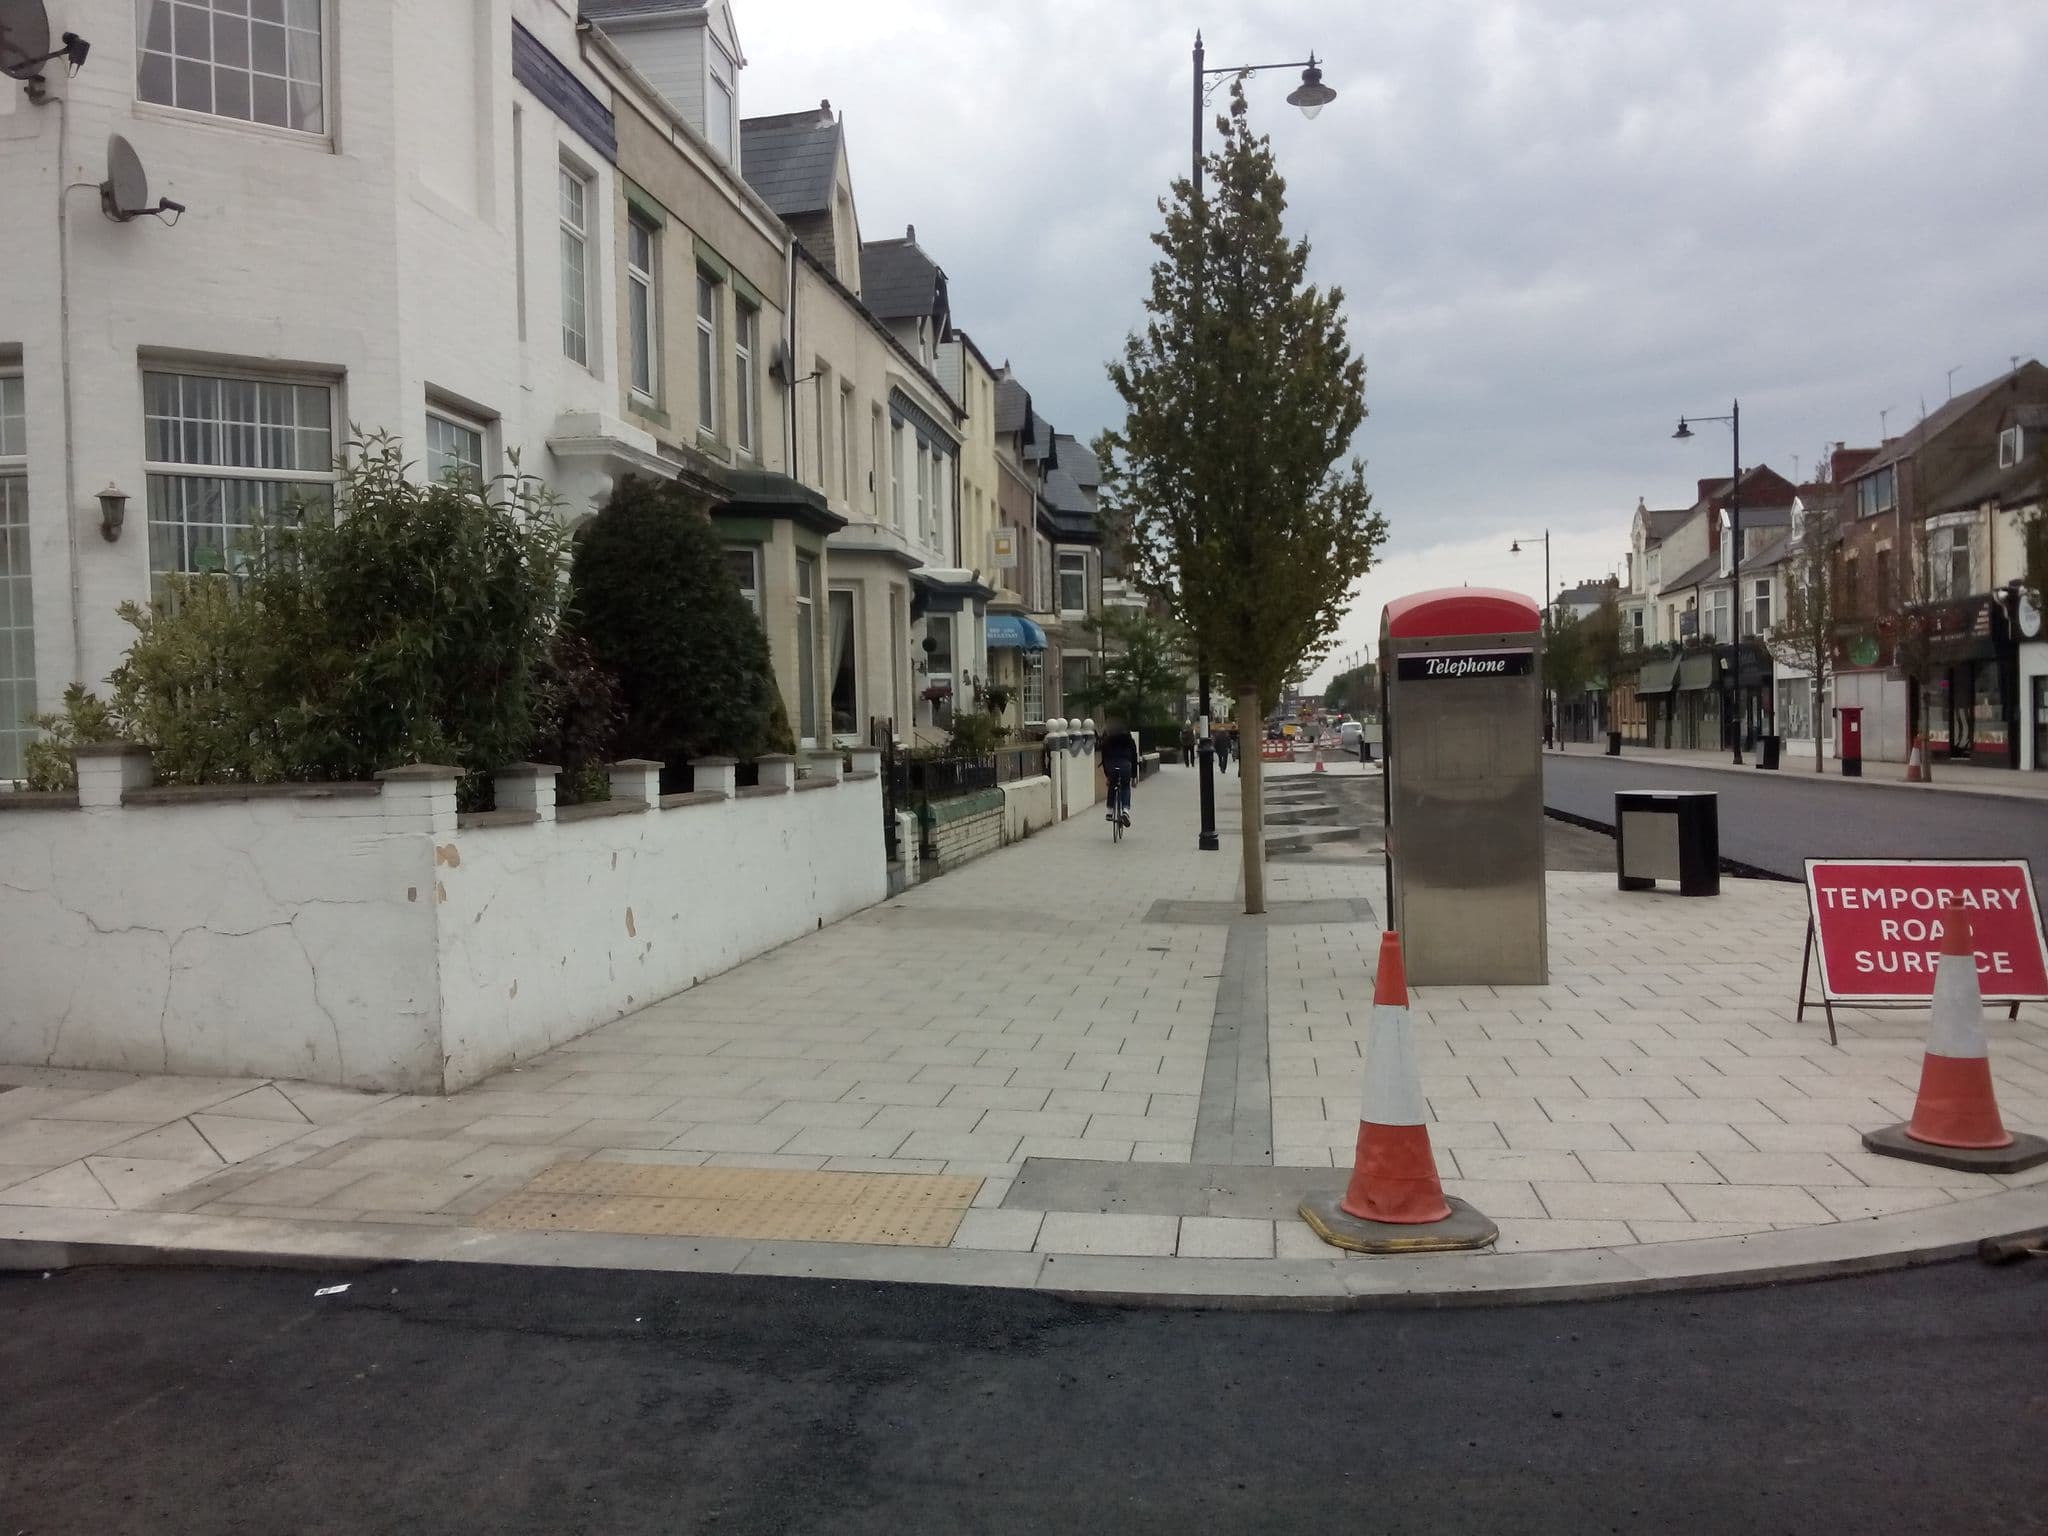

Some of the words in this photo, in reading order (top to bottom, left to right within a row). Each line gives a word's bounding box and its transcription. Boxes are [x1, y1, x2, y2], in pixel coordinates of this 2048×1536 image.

[1426, 658, 1505, 676] Telephone
[1822, 888, 2020, 909] TEMPORARY
[1881, 920, 1973, 941] ROA
[1856, 952, 2013, 973] SURFCE
